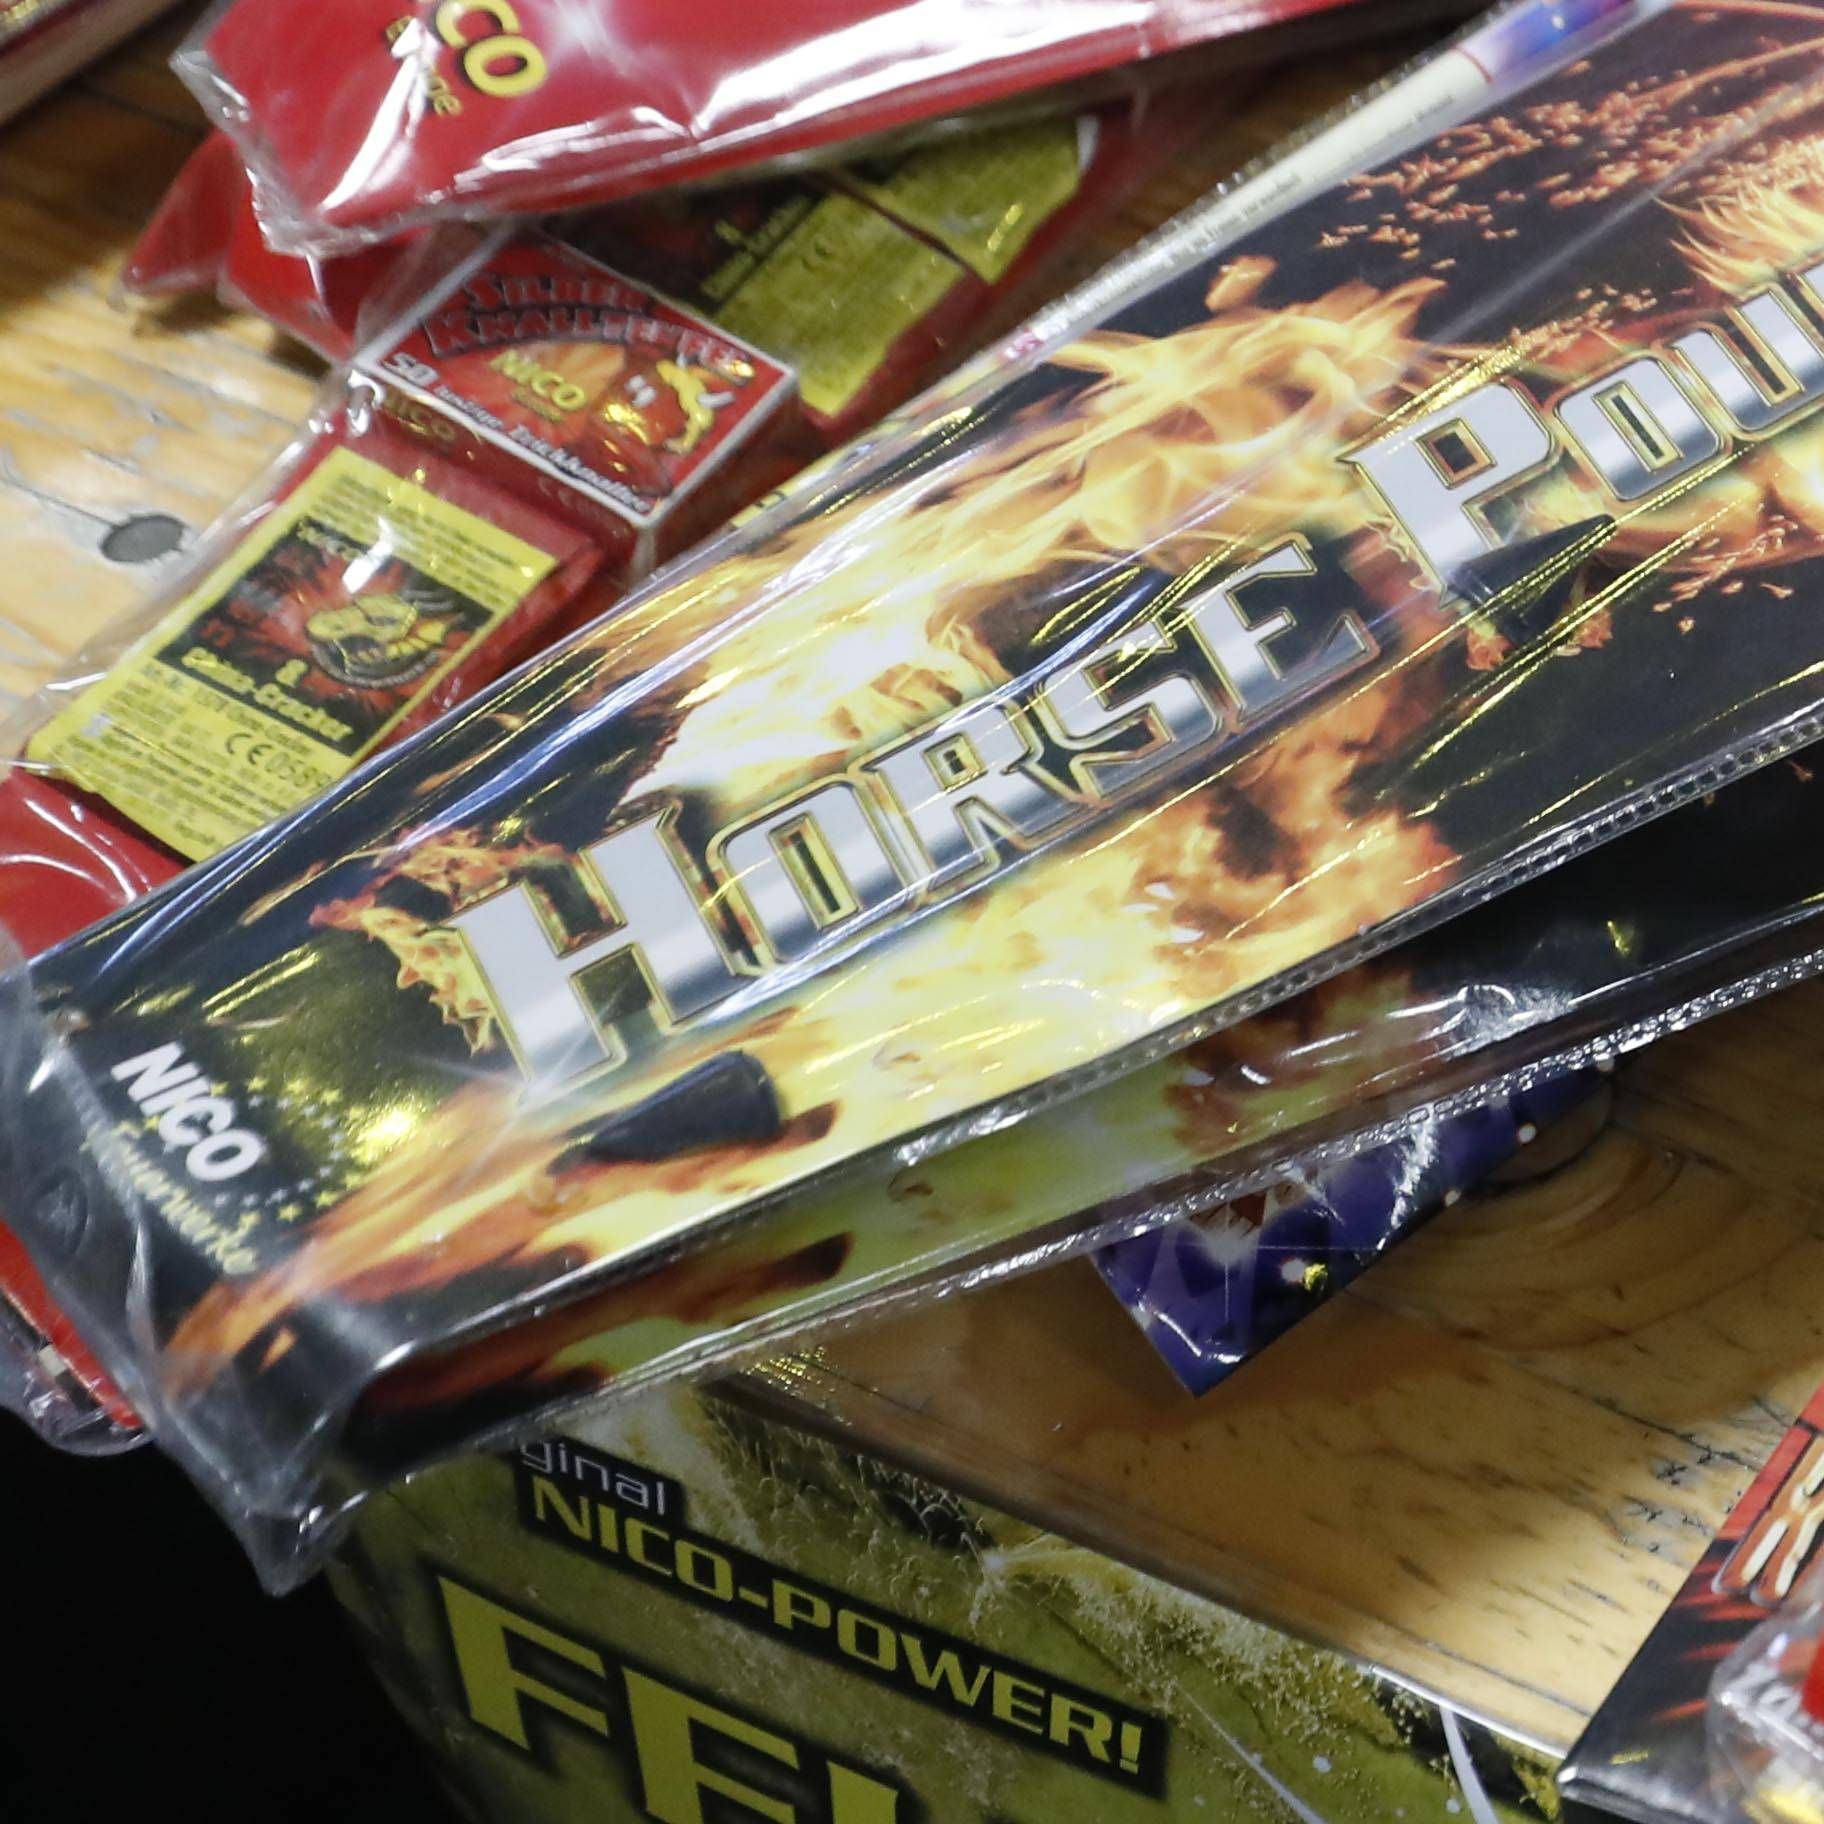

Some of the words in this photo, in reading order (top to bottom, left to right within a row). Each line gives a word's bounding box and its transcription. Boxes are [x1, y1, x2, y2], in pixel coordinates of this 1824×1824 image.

[488, 350, 590, 414] NICO
[452, 534, 1384, 1106] HORSE
[108, 1040, 272, 1184] NICO
[532, 1476, 1146, 1778] NICO-POWER!
